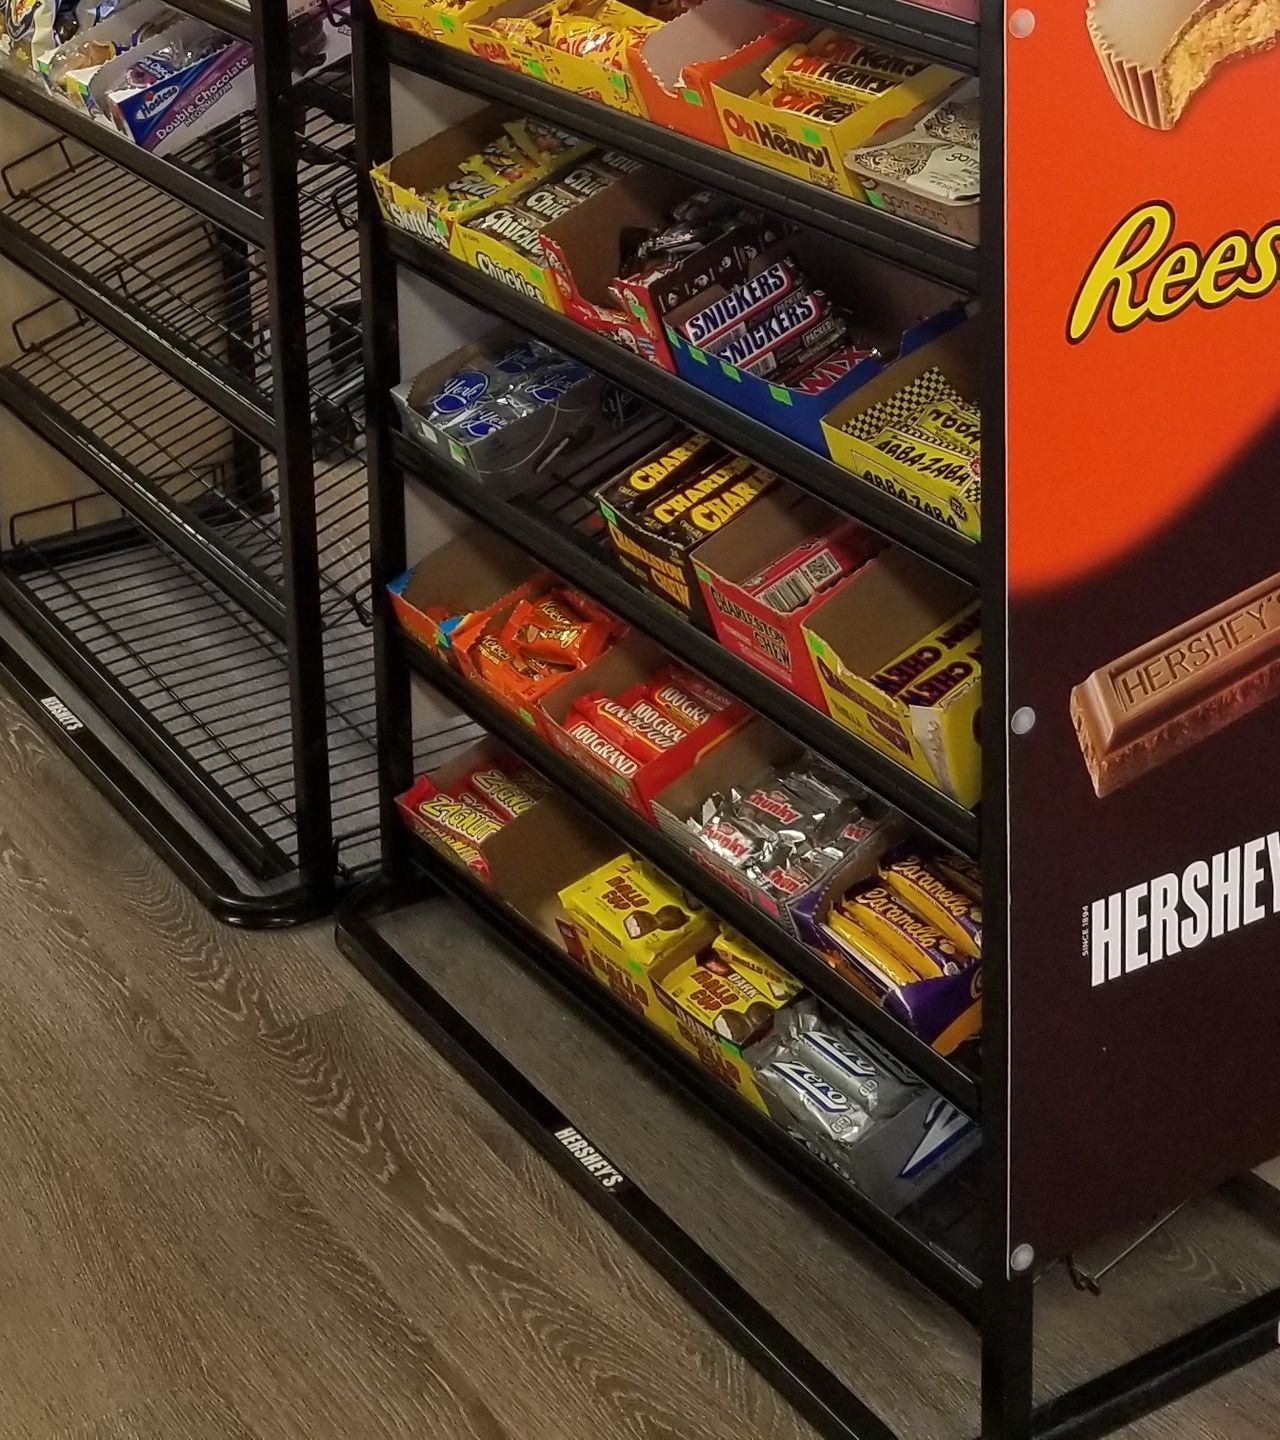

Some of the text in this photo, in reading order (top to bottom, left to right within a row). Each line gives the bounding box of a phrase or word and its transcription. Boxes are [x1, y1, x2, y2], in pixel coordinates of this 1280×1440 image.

[137, 82, 180, 122] Hostess
[155, 55, 250, 141] Double Chocolate
[721, 107, 836, 174] Oh Henry!
[476, 250, 546, 305] Chuckles
[688, 266, 787, 339] SNICKERS
[719, 296, 817, 364] SNICKERS
[804, 318, 835, 346] PACKED
[434, 373, 481, 403] York
[875, 439, 970, 487] ABBA-ZABA
[709, 583, 788, 649] CHARLESTON
[753, 629, 793, 672] CHEW
[39, 695, 85, 732] HERSHEY'S
[571, 724, 639, 775] 100 GRAND
[420, 794, 503, 843] ZAGNUT
[605, 875, 651, 908] MALLO
[890, 856, 971, 916] Caramello
[855, 886, 937, 949] Caramello
[1081, 904, 1090, 957] SINCE 1894
[689, 989, 723, 1012] CUP
[690, 969, 740, 1006] MALLO
[727, 973, 758, 999] DARK
[801, 1030, 877, 1077] Zero
[770, 1060, 850, 1113] Zero
[554, 1126, 624, 1193] HERSHEY'S
